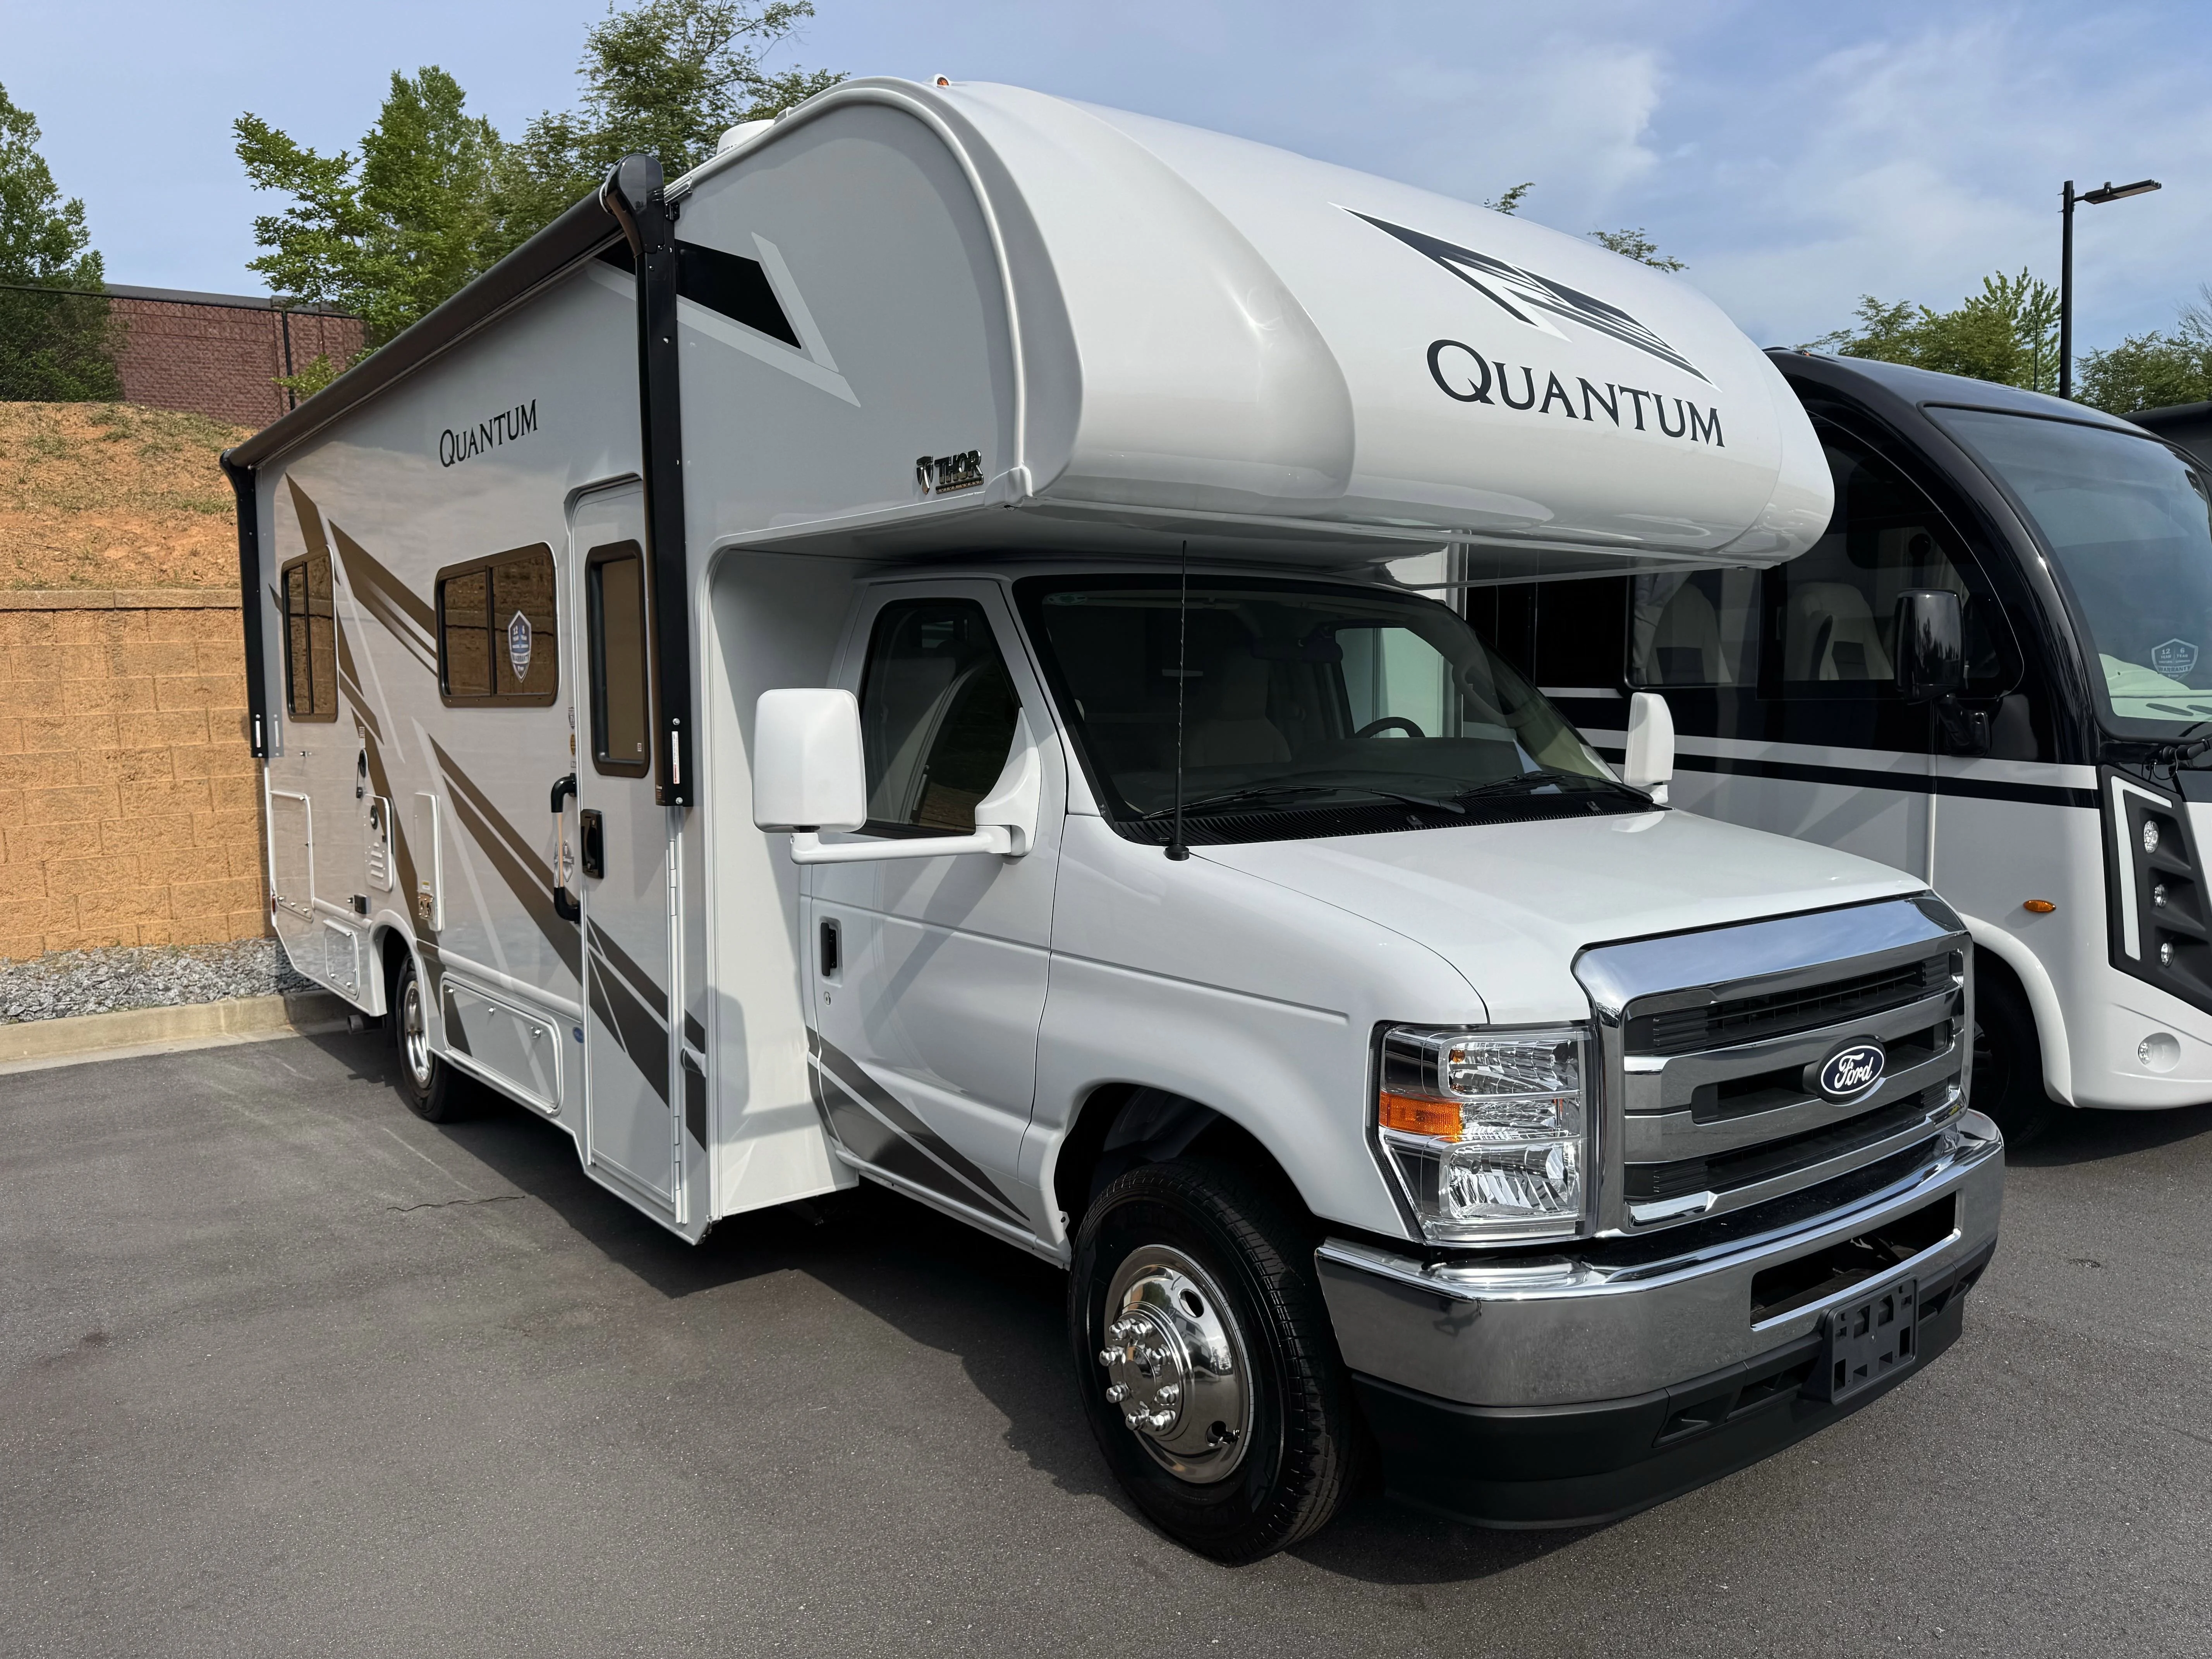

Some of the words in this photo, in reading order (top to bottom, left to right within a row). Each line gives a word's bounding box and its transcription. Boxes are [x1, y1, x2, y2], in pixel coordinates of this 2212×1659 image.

[1427, 339, 1725, 448] QUANTUM
[440, 399, 538, 467] QUANTUM
[934, 449, 983, 484] THOR
[1834, 1052, 1873, 1089] Ford
